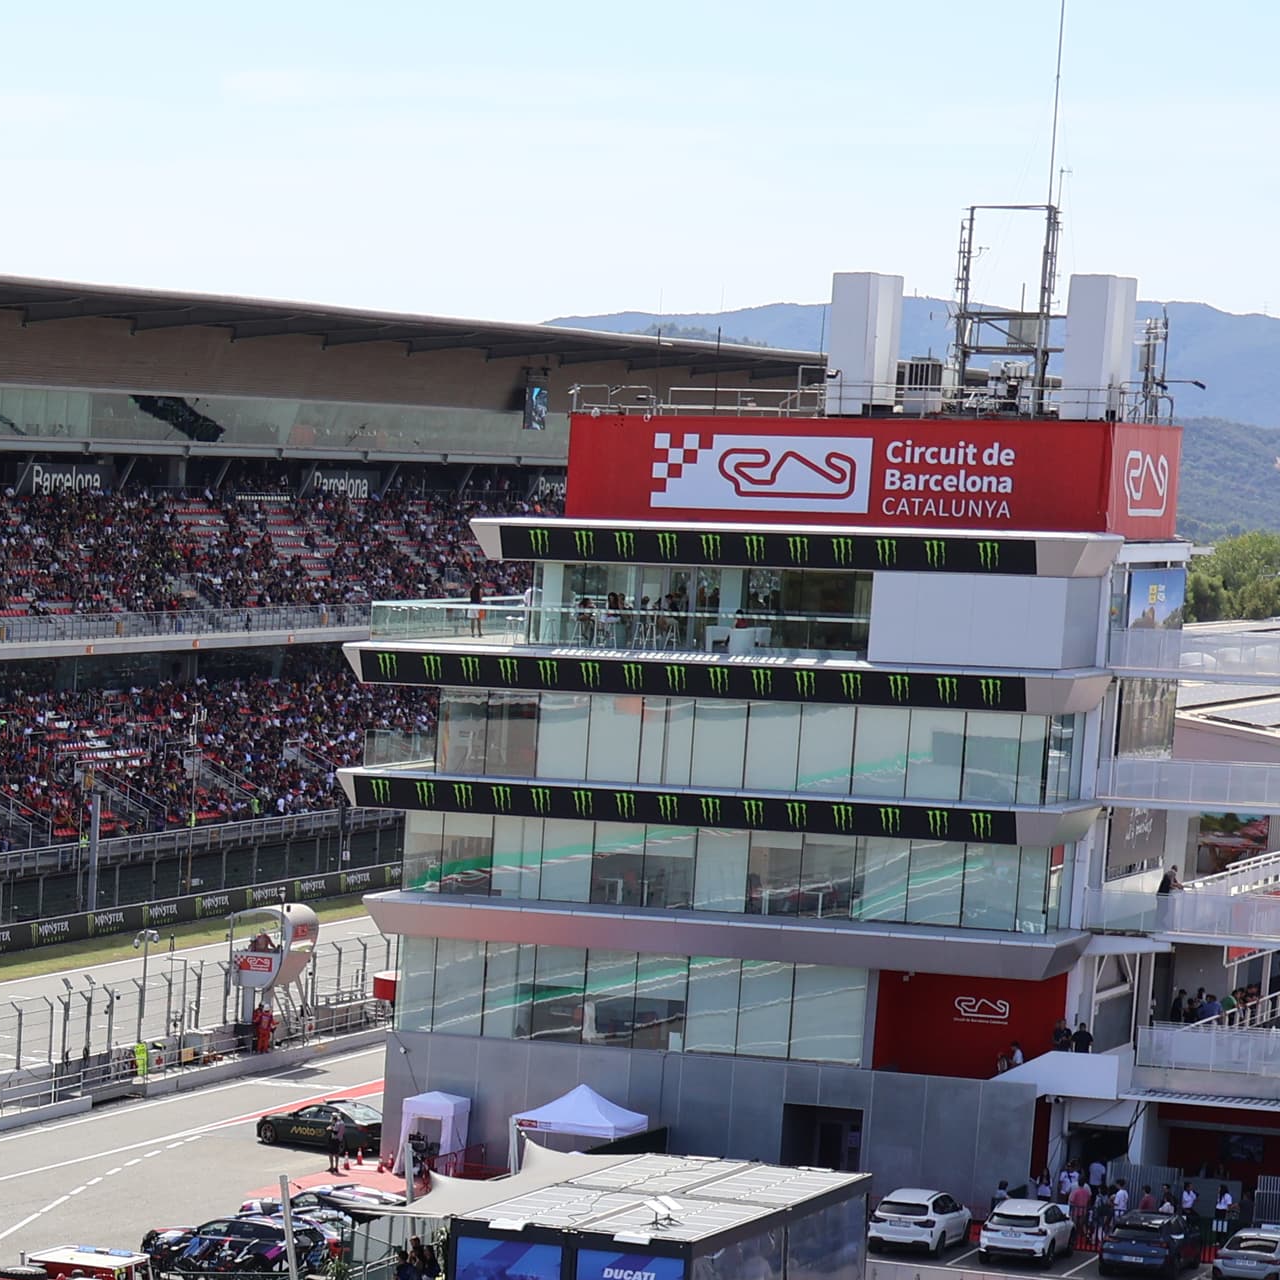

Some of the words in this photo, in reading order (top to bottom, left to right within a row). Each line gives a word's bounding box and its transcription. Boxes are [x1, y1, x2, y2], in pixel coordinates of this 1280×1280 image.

[886, 440, 978, 467] Circuit
[982, 442, 1016, 467] de
[884, 468, 1014, 494] Barcelona
[881, 496, 1012, 519] CATALUNYA
